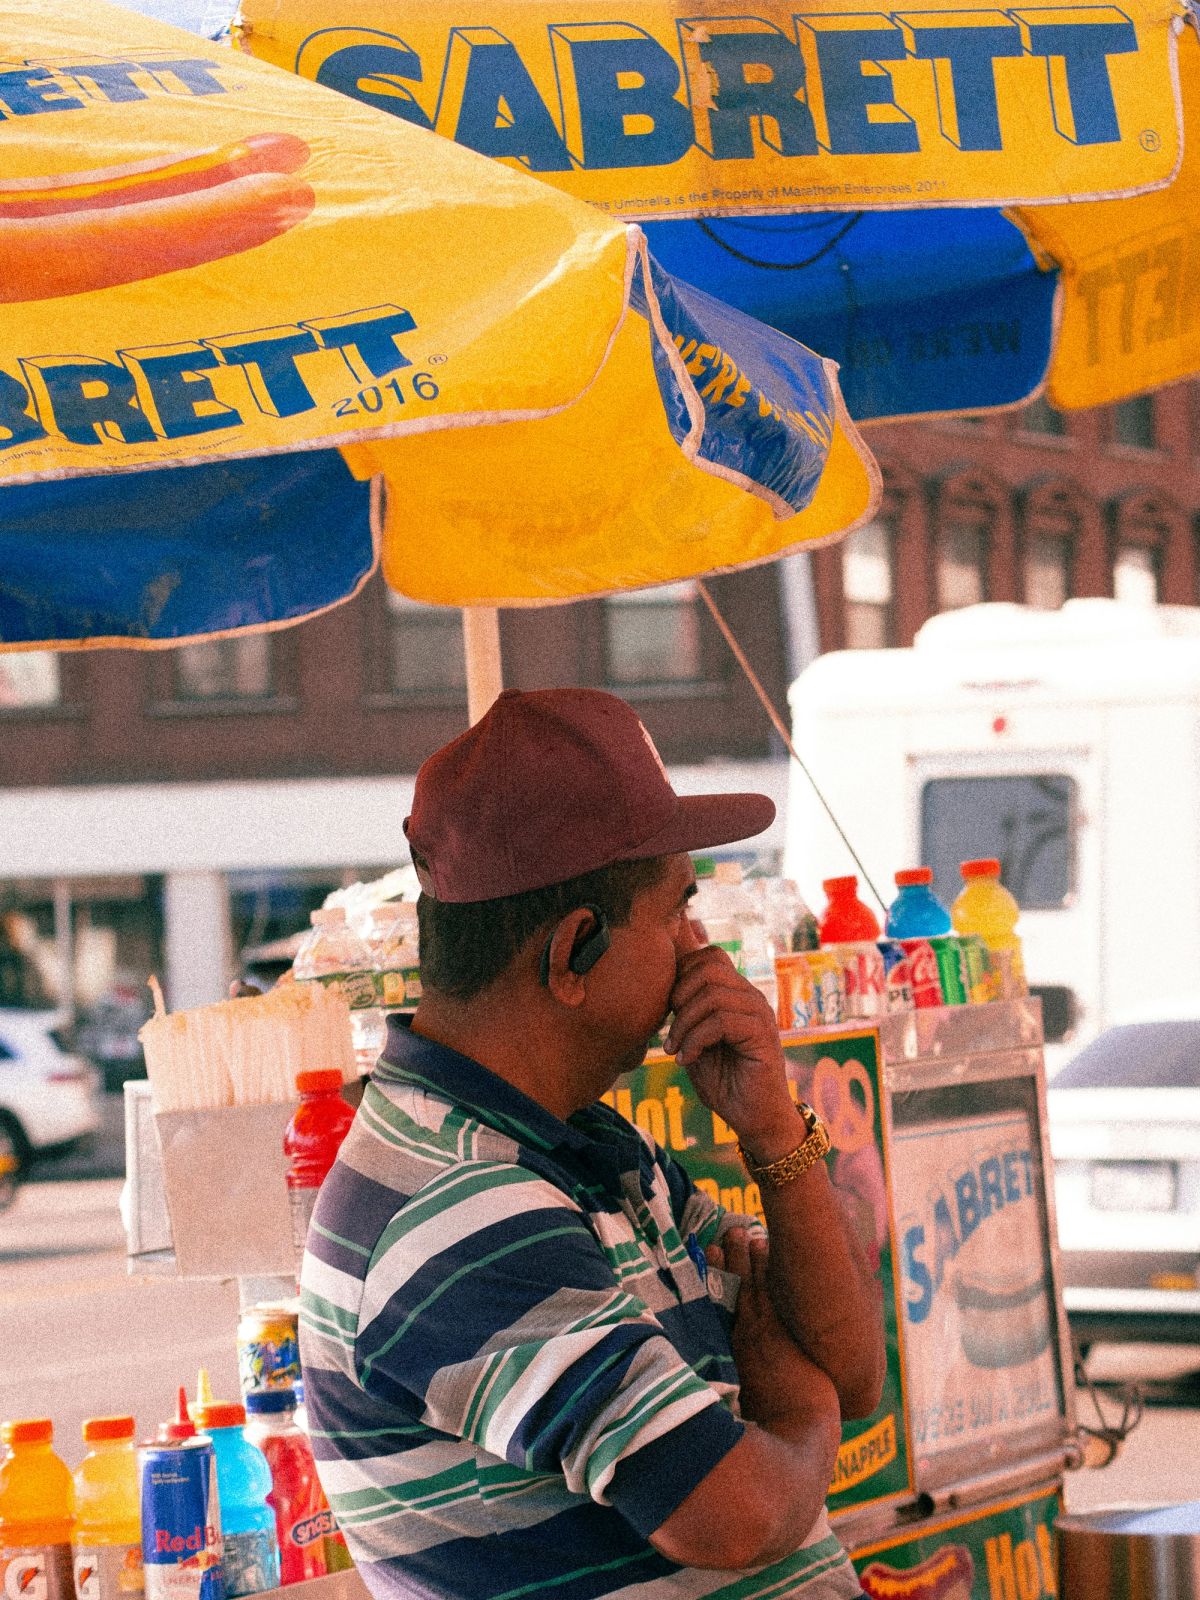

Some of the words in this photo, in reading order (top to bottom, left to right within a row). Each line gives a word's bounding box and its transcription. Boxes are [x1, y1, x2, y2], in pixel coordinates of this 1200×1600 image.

[0, 54, 229, 122] ETT
[295, 6, 1139, 172] SABRETT
[614, 194, 671, 210] Umbrella
[674, 194, 685, 205] is
[689, 191, 709, 203] the
[711, 186, 765, 203] Property
[767, 187, 778, 199] of
[782, 184, 841, 197] Marathon
[844, 182, 913, 196] Enterprises
[331, 372, 439, 418] 2016
[902, 1150, 1033, 1325] SABRET
[155, 1525, 201, 1553] Red
